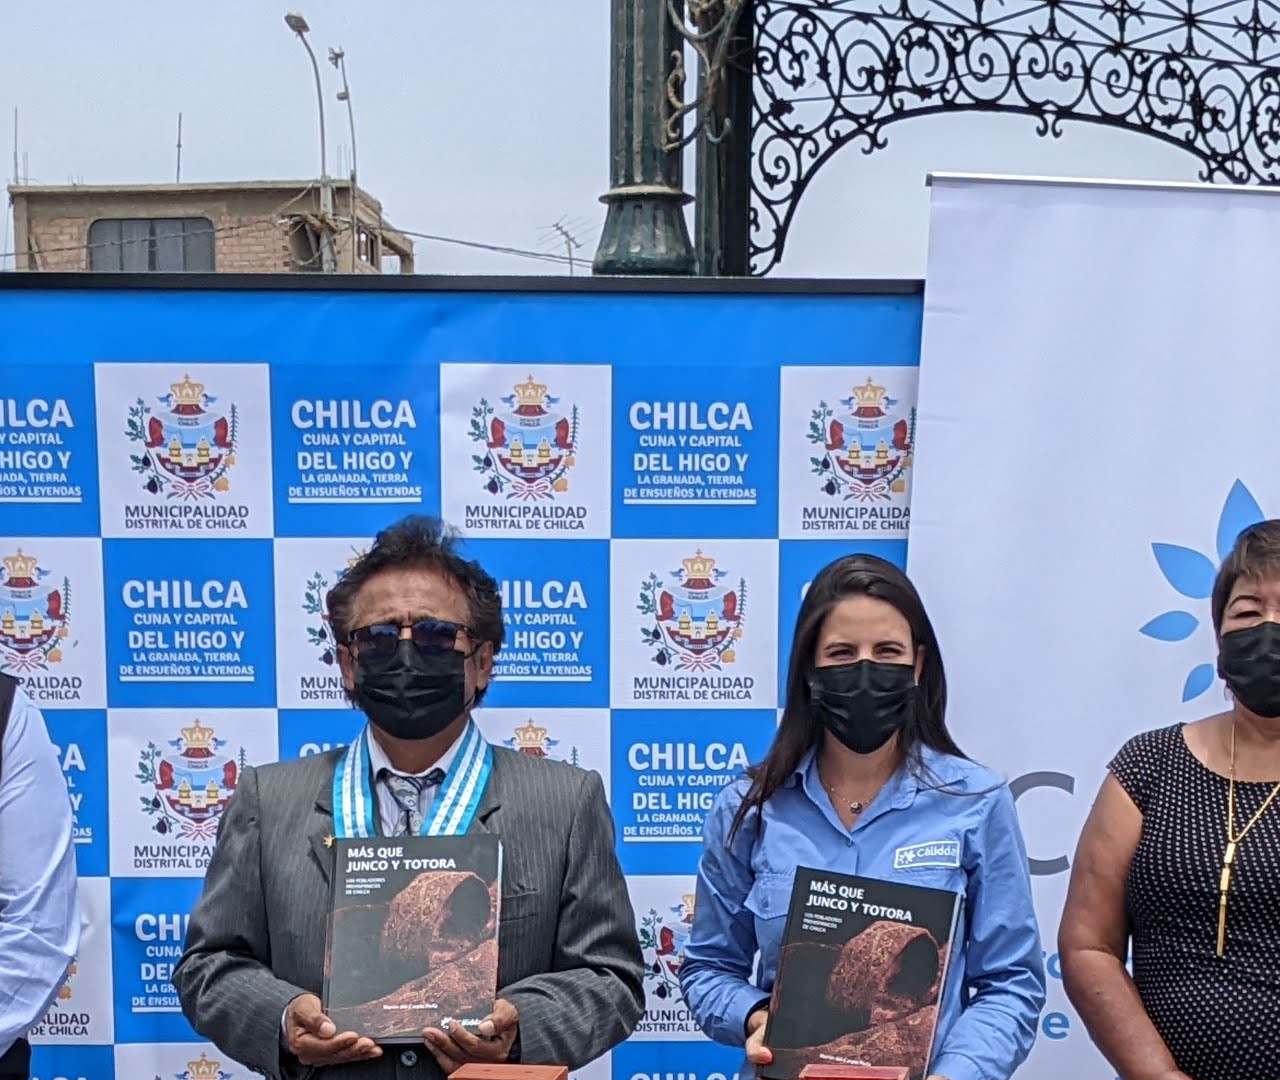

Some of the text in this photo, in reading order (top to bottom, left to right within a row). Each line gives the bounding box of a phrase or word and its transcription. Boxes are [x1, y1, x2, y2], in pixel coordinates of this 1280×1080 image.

[292, 400, 416, 428] CHILCA
[630, 402, 752, 430] CHILCA
[9, 432, 63, 444] CAPITAL
[303, 433, 406, 445] CUNA Y CAPITAL
[640, 435, 741, 447] CUNA Y CAPITAL
[0, 451, 53, 469] HIGO
[58, 452, 71, 469] Y
[298, 452, 412, 469] DEL HIGO Y
[634, 454, 748, 471] DEL HIGO Y
[30, 473, 67, 482] TIERRA
[302, 473, 408, 484] LA GRANADA, TIERRA
[638, 475, 743, 485] LA GRANADA, TIERRA
[19, 486, 81, 496] Y LEYENDAS
[289, 485, 421, 496] DE ENSUEÑOS Y LEYENDAS
[624, 487, 756, 498] DE ENSUEÑOS Y LEYENDAS
[125, 505, 248, 518] MUNICIPALIDAD
[466, 505, 586, 518] MUNICIPALIDAD
[803, 507, 910, 519] MUNICIPALIDA
[125, 519, 247, 529] DISTRITAL DE CHILCA
[466, 519, 584, 529] DISTRITAL DE CHILCA
[803, 521, 859, 530] DISTRITAL
[863, 521, 877, 530] DE
[123, 580, 247, 608] CHILCA
[134, 613, 237, 625] CUNA Y CAPITAL
[514, 614, 576, 625] Y CAPITAL
[129, 631, 244, 648] DEL HIGO Y
[515, 632, 583, 648] HIGO Y
[134, 653, 240, 662] LA GRANADA, TIERRA
[543, 653, 578, 662] TIERRA
[120, 664, 254, 675] DE ENSUEÑOS Y LEYENDAS
[532, 666, 592, 675] Y LEYENDAS
[634, 677, 754, 689] MUNICIPALIDAD
[39, 690, 80, 700] CHILCA
[634, 690, 751, 699] DISTRITAL DE CHILCA
[629, 743, 750, 770] CHILCA
[639, 775, 736, 786] CUNA Y CAPITA
[633, 793, 713, 809] DEL HIG
[637, 814, 703, 824] LA GRANADA,
[624, 824, 701, 835] DE ENSUEÑOS Y
[134, 846, 217, 857] MUNICIPA
[347, 846, 403, 859] MÁS QUE
[134, 859, 192, 868] DISTRITAL
[346, 859, 456, 873] JUNCO Y TOTORA
[810, 880, 865, 900] MÁS QUE
[805, 895, 913, 922] JUNCO Y TOTORA
[147, 946, 183, 957] CUNA
[49, 1026, 88, 1035] CHILCA
[635, 1023, 690, 1032] DISTRITAL
